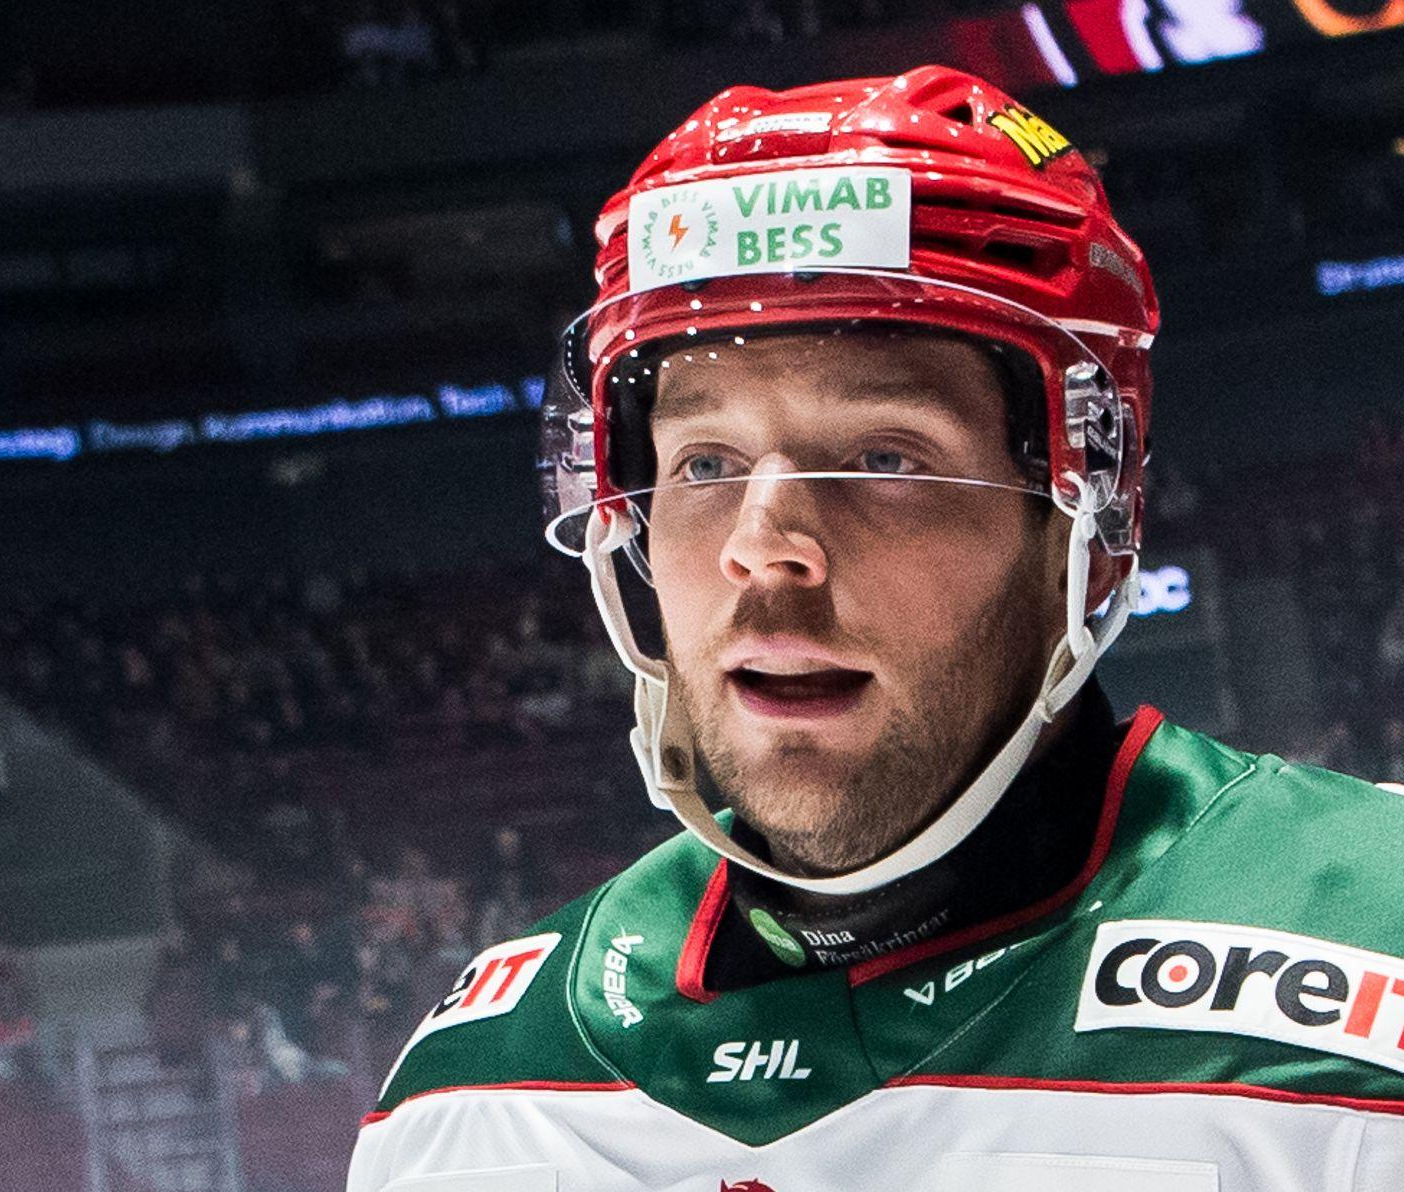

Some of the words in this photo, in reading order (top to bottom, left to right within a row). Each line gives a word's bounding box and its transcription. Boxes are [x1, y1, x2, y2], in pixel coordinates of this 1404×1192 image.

[731, 175, 894, 219] VIMAB
[736, 222, 844, 267] BESS
[801, 926, 855, 948] Dina
[706, 1039, 813, 1083] SHL
